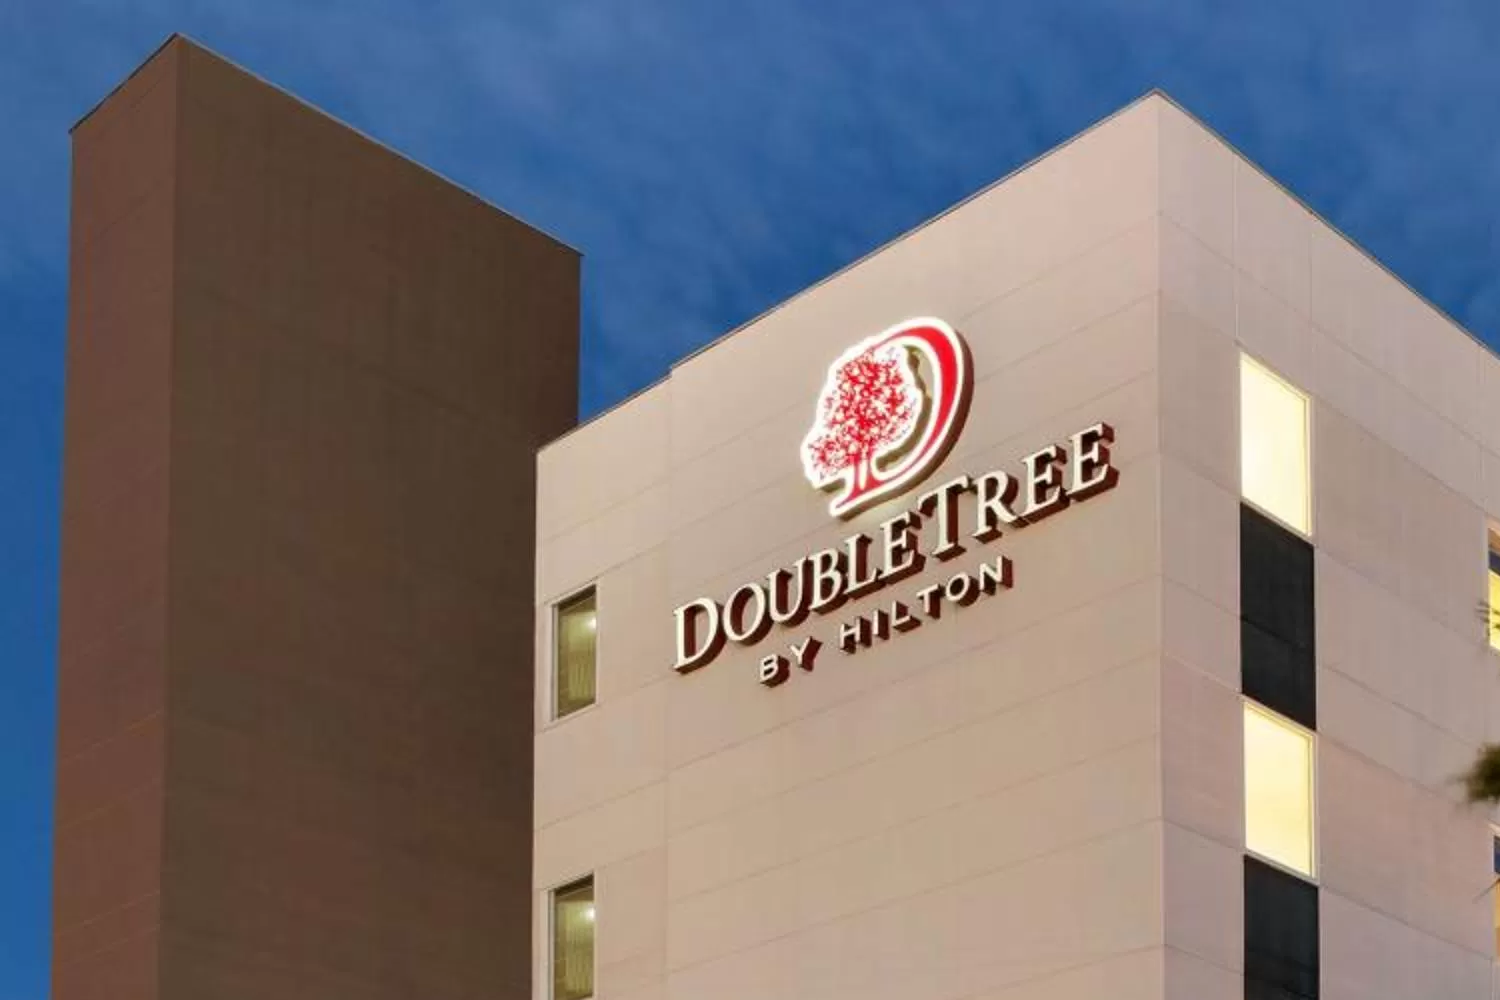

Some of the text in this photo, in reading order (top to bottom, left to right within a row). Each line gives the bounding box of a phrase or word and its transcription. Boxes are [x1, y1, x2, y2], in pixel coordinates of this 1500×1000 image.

[672, 421, 1117, 674] DOUBLETREE
[759, 555, 1012, 686] BY HILTON
